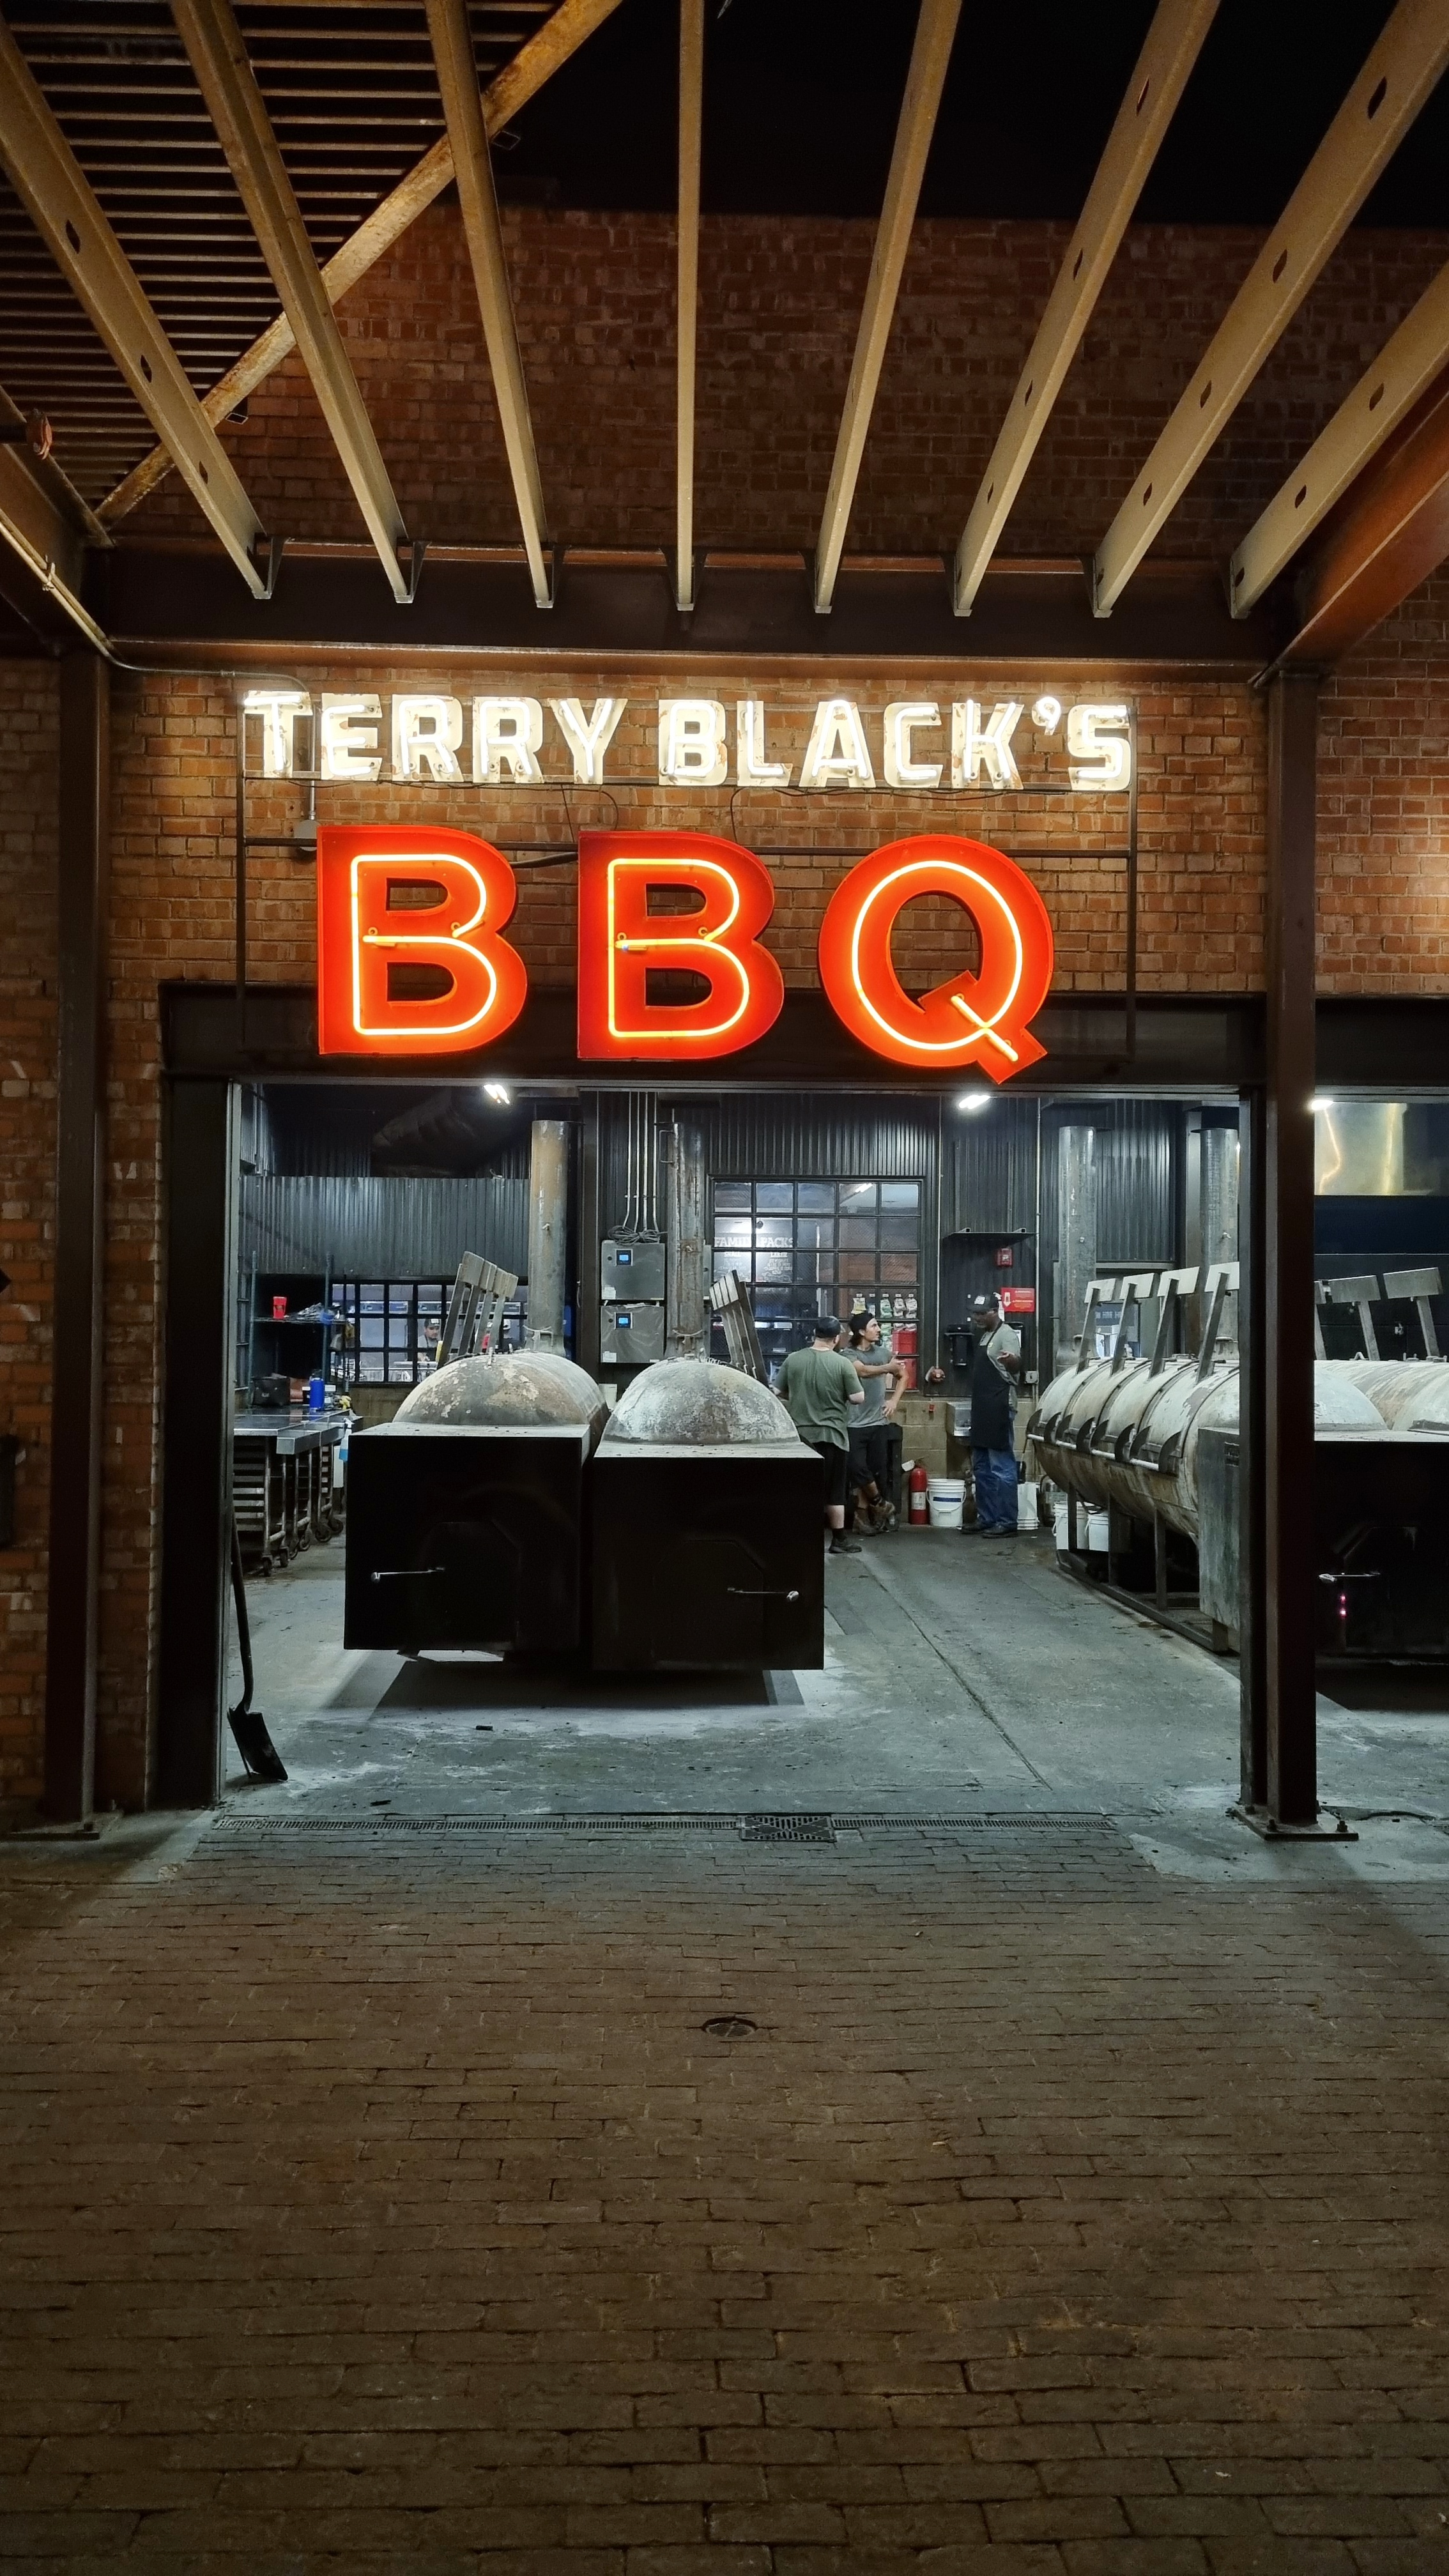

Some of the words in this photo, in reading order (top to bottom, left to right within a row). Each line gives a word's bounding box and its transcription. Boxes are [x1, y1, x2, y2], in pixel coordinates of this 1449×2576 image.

[243, 690, 628, 785] TERRY
[658, 696, 1131, 791] BLACK'S
[316, 825, 1054, 1084] BBQ
